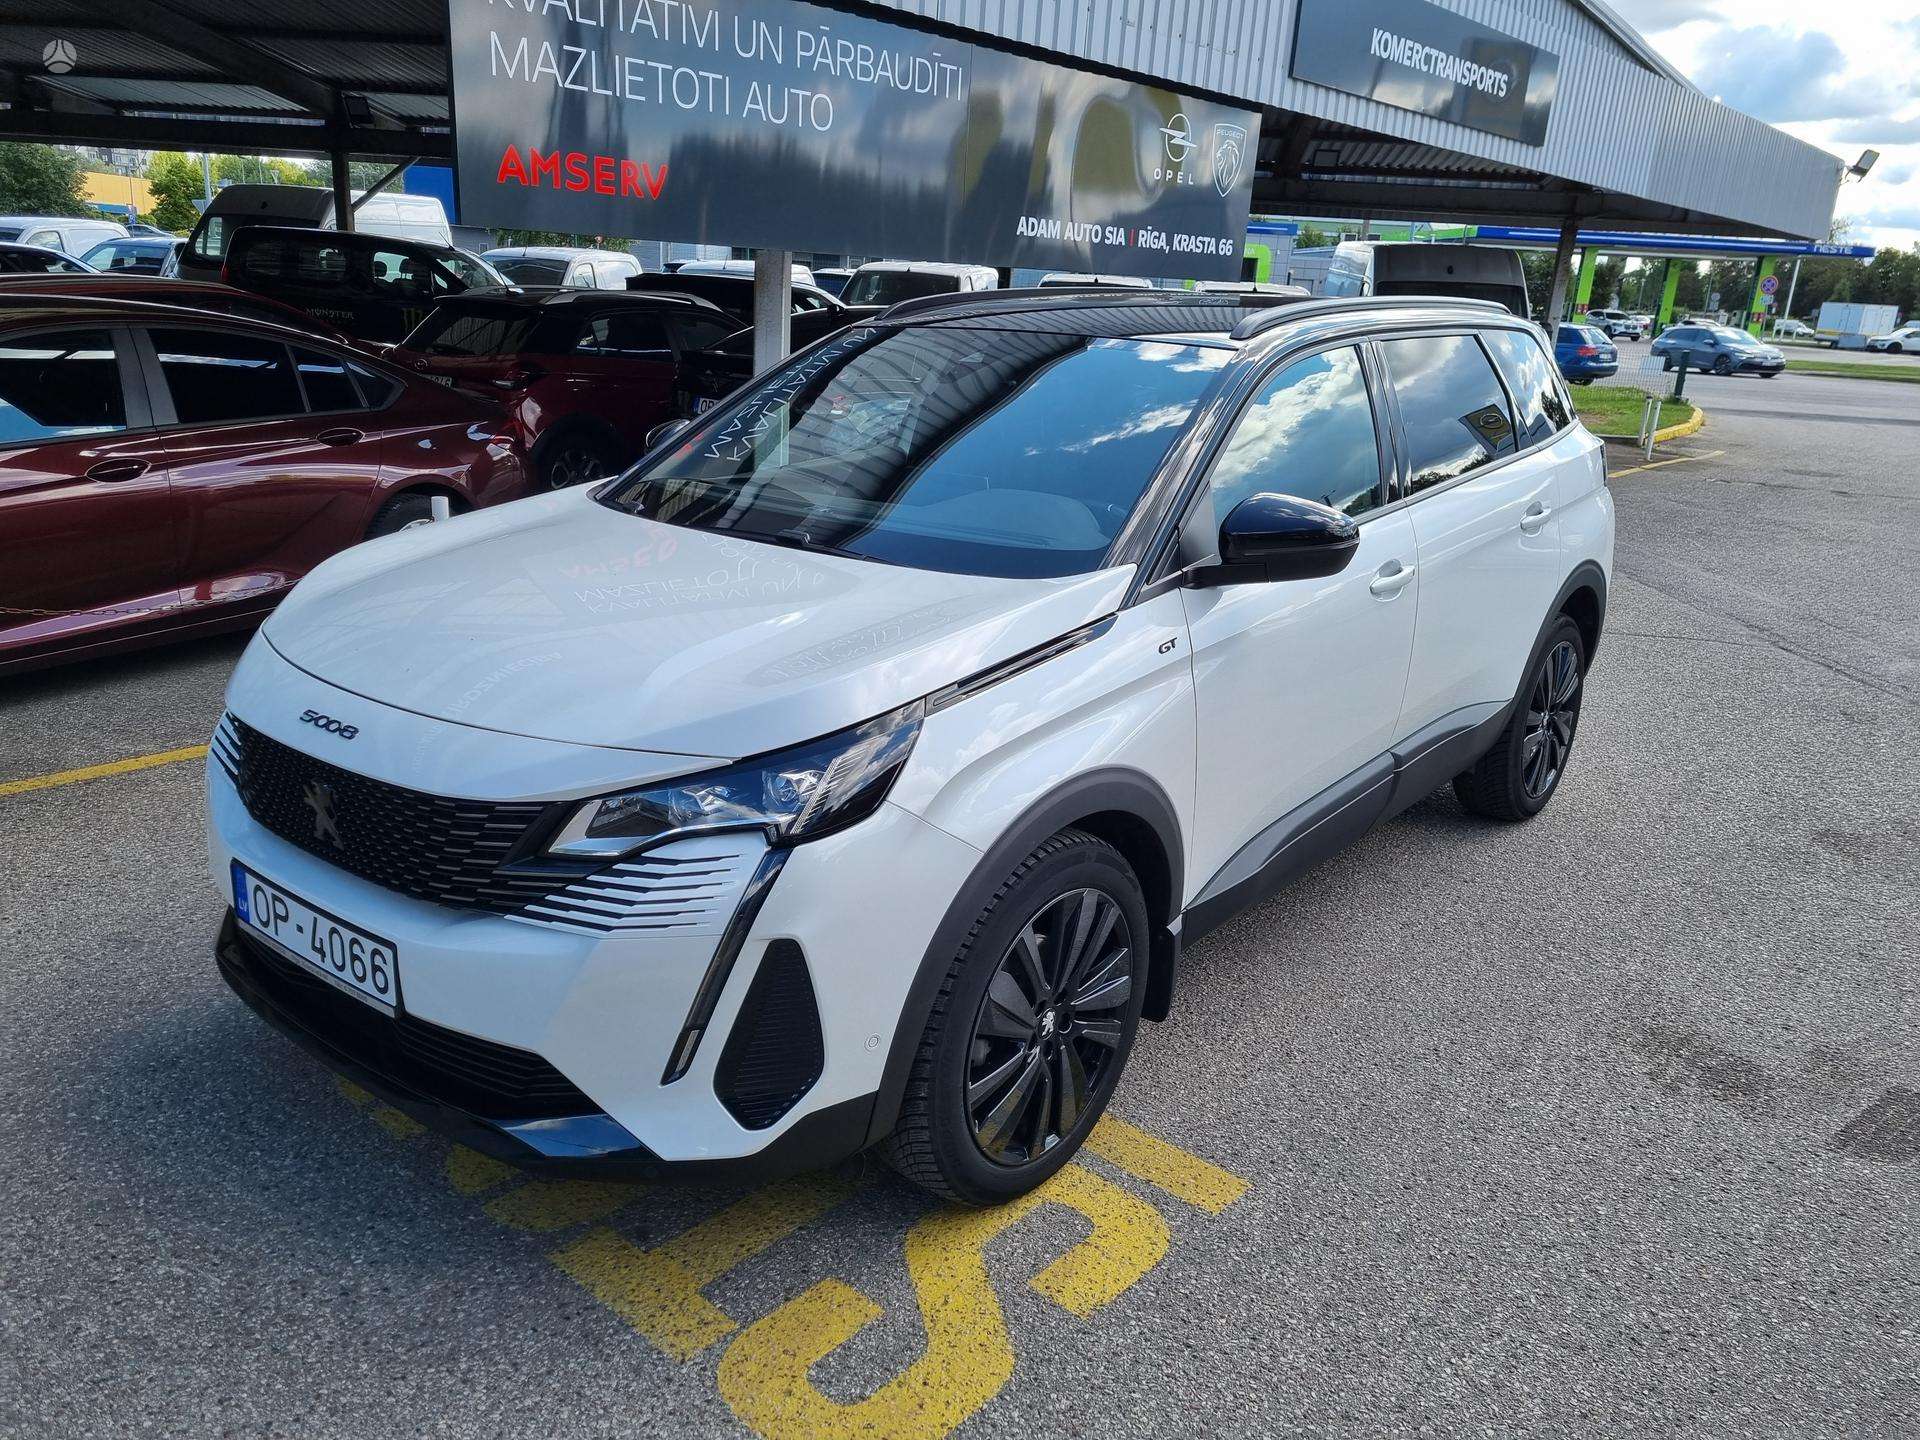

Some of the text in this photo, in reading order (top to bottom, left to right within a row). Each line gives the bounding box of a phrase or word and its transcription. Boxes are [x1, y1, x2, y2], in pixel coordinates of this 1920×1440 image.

[490, 30, 834, 131] MAZLIETOTI AUTO
[734, 16, 783, 64] UN
[796, 26, 962, 101] PĀRBAUDĪTI
[1370, 27, 1509, 98] KOMERCTRANSPORTS
[1216, 128, 1244, 140] PEUGEOT
[497, 144, 669, 200] AMSERV
[1153, 167, 1194, 185] OPEL
[1016, 216, 1061, 240] ADAM
[1064, 221, 1102, 244] AUTO
[1105, 226, 1126, 246] SIA
[1138, 226, 1170, 254] RĪGA,
[1173, 233, 1216, 255] KRASTA
[1218, 239, 1233, 256] 66
[1158, 637, 1177, 654] GT
[300, 709, 360, 740] 5008
[253, 884, 389, 995] OP-4066
